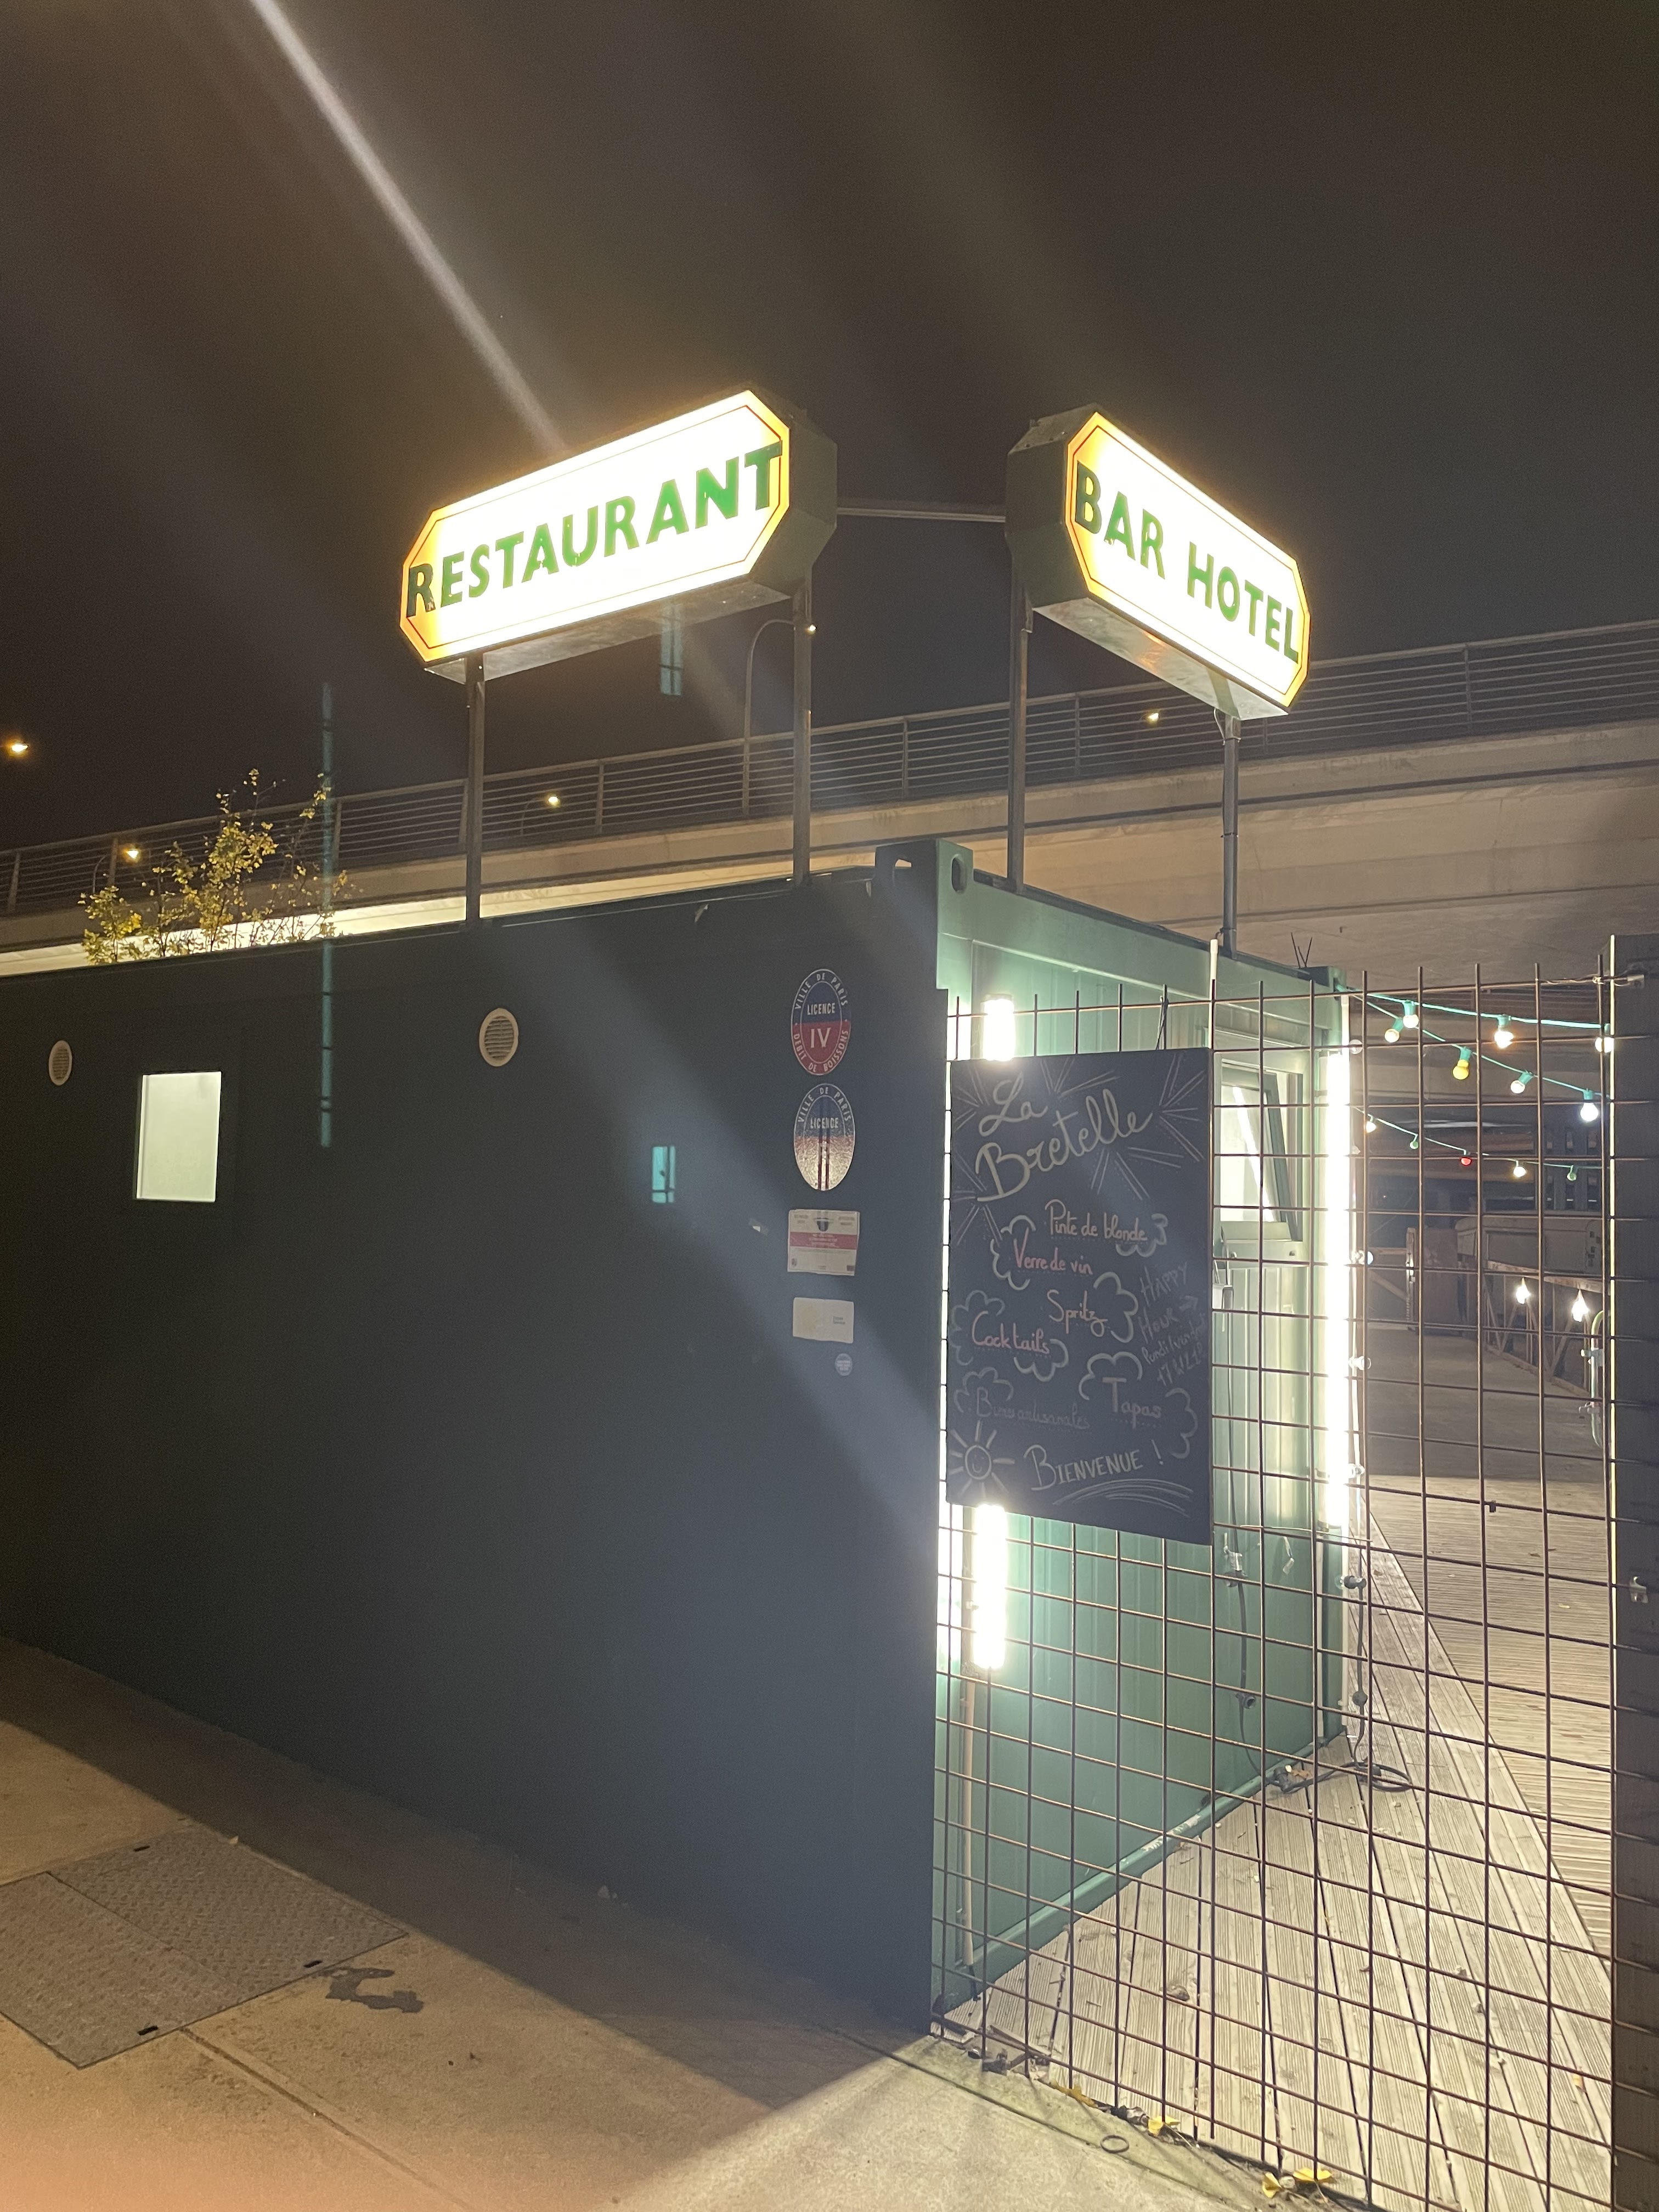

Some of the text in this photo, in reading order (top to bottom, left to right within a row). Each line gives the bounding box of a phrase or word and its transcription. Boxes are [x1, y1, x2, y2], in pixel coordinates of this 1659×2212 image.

[406, 440, 783, 618] RESTAURANT
[1075, 459, 1299, 665] BAR HOTEL
[794, 972, 848, 1009] VILLE DE PARIS
[807, 1002, 836, 1015] LICENCE
[793, 1030, 849, 1073] DEBIT DE BOISSONS
[810, 1027, 831, 1049] IV
[797, 1094, 814, 1122] VILLE
[833, 1091, 851, 1121] PARIS
[978, 1070, 1048, 1137] La
[975, 1088, 1153, 1202] Bretelle
[1045, 1198, 1148, 1242] Pinte de blonde
[1013, 1227, 1093, 1276] Verre de vin
[972, 1310, 1050, 1355] Cocktails
[1046, 1289, 1108, 1338] Spritz
[1102, 1377, 1163, 1429] Tapas
